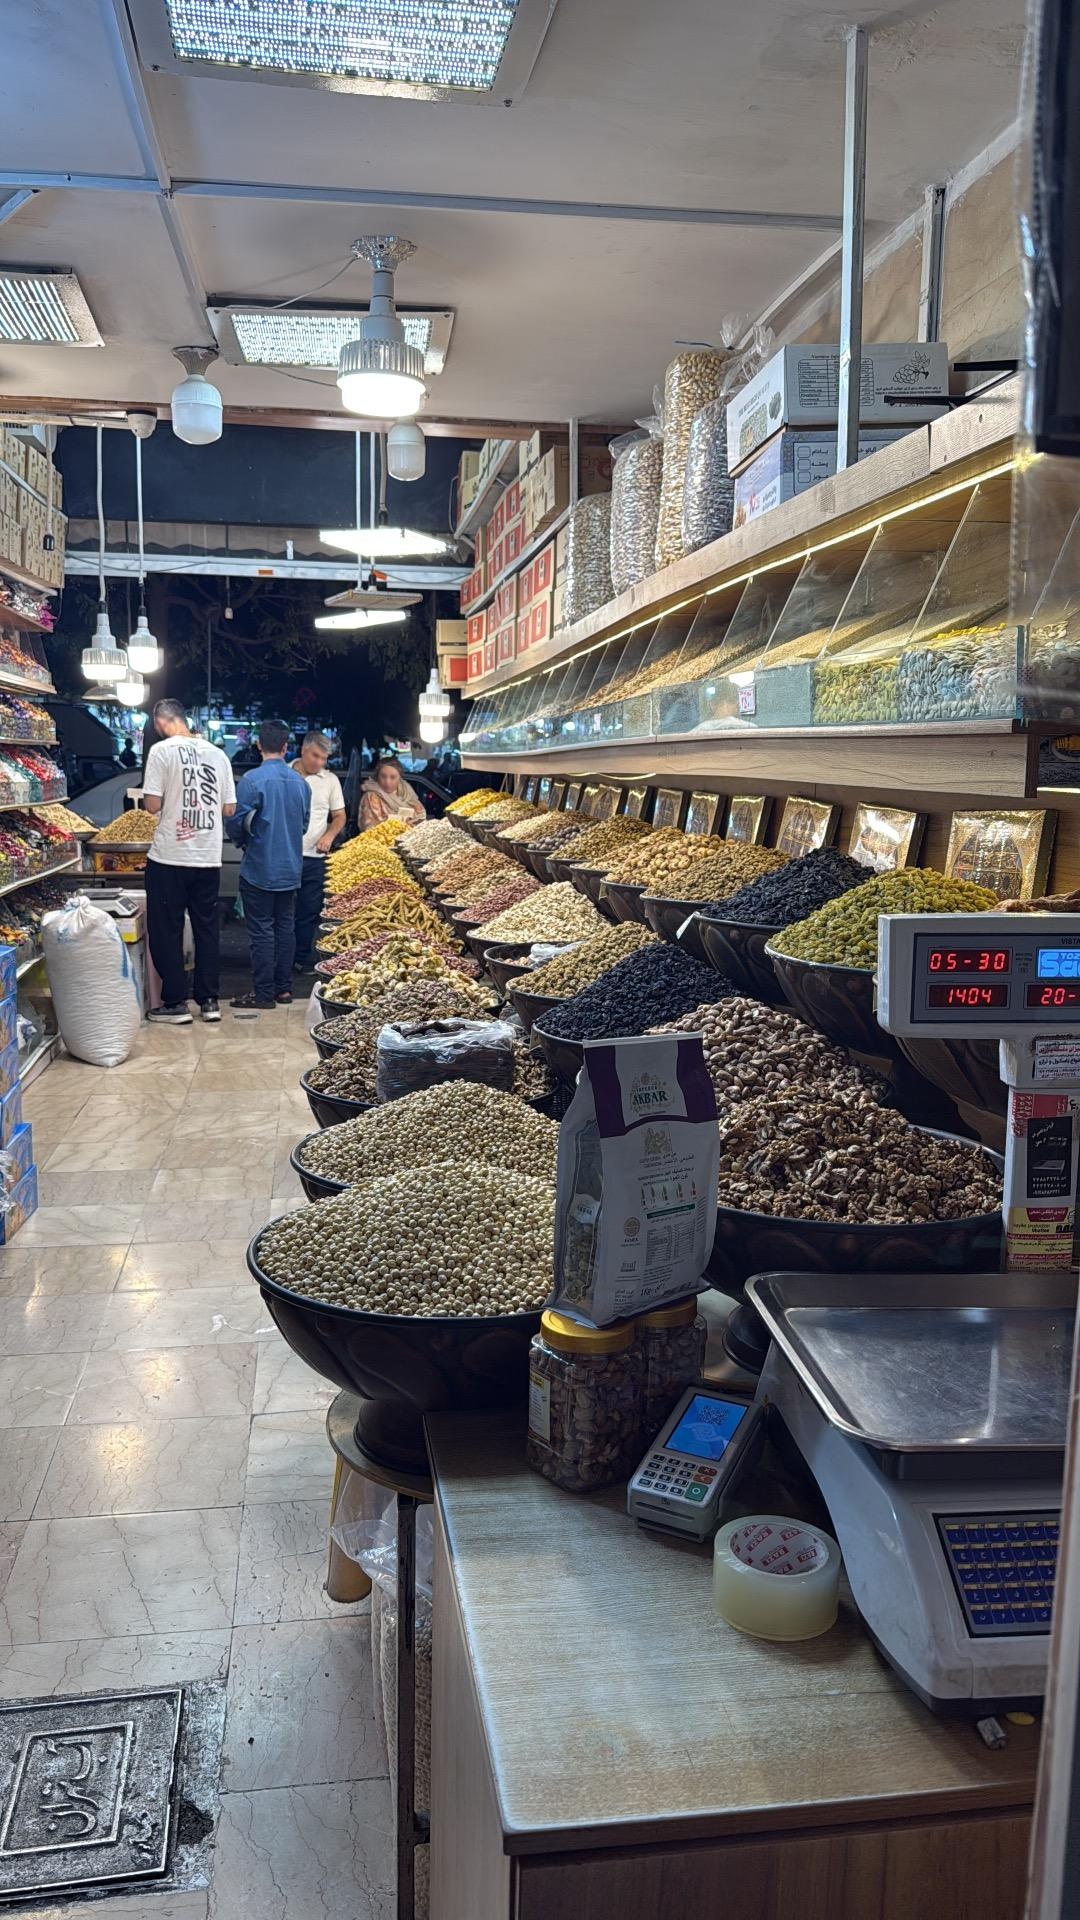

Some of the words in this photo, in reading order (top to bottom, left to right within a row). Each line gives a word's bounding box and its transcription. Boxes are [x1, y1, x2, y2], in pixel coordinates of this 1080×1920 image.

[178, 746, 199, 766] CHI
[182, 767, 198, 788] CA
[197, 763, 219, 806] 1966
[182, 788, 198, 808] GO
[181, 809, 215, 830] BULLS
[929, 952, 1007, 971] 05-30
[948, 987, 992, 1005] 1404
[632, 1090, 669, 1105] AKBAR
[37, 1780, 101, 1837] تهران
